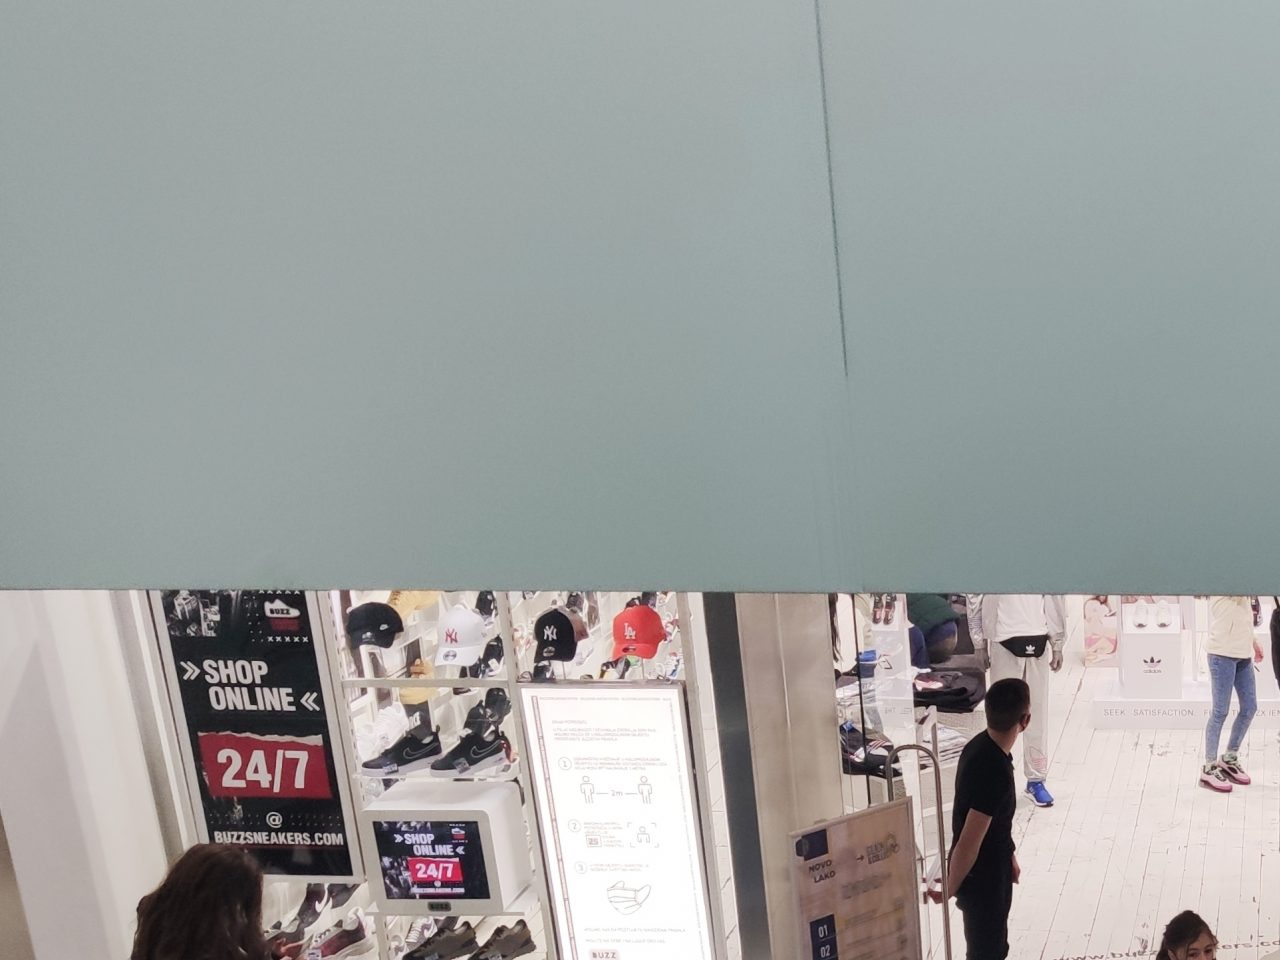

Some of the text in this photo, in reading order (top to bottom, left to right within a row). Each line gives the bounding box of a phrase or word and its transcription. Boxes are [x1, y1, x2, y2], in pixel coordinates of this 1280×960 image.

[202, 659, 269, 684] SHOP
[208, 686, 297, 711] ONLINE
[1103, 708, 1126, 717] SEEK
[1133, 708, 1195, 717] SATISFACTION
[217, 748, 309, 793] 24/7
[266, 811, 283, 829] @
[214, 831, 344, 846] BUZZSNEAKERS.COM
[404, 833, 435, 845] SHOP
[413, 845, 454, 856] ONLINE
[415, 863, 454, 880] 24/7
[809, 860, 832, 873] NOVO
[814, 870, 836, 883] LAKO
[818, 924, 828, 938] 01
[592, 951, 617, 959] BUZZ
[820, 944, 831, 958] 02
